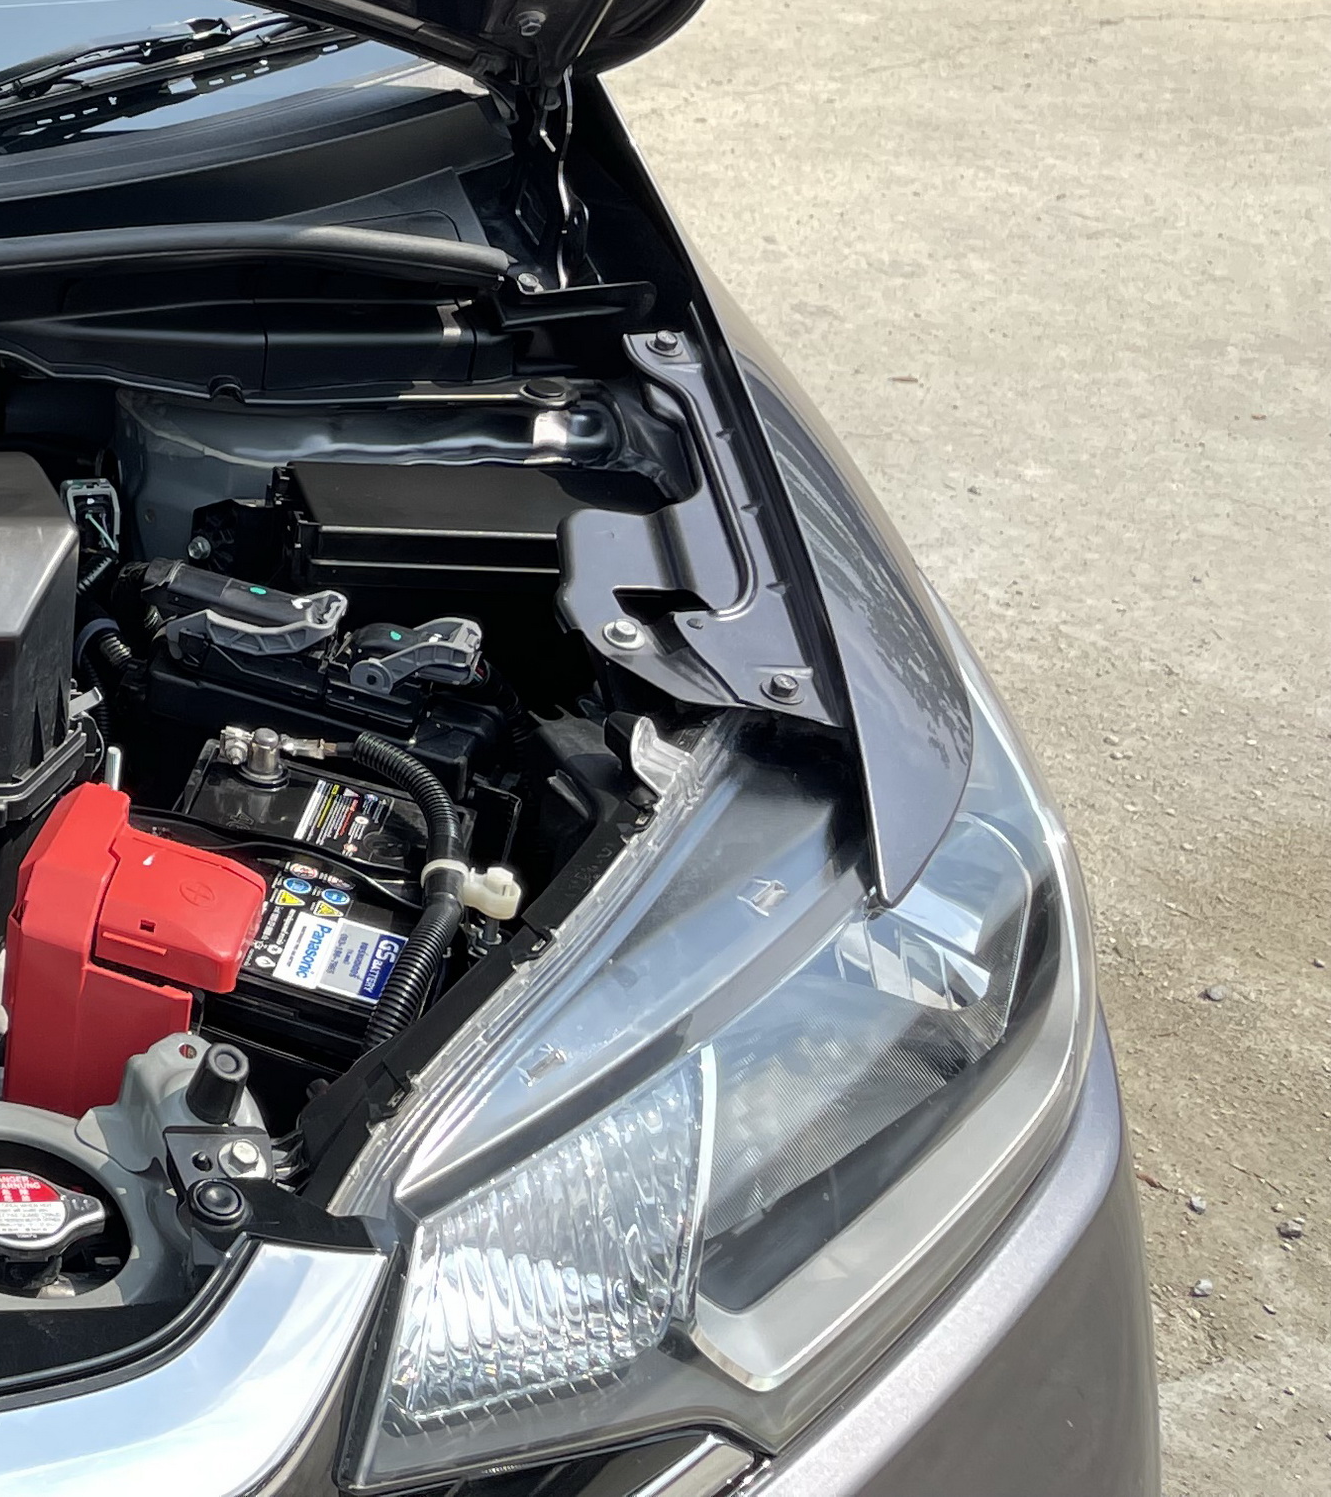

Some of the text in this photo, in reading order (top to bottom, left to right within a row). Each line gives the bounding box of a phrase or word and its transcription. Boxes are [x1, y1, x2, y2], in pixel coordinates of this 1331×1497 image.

[296, 923, 333, 979] Panasonic
[363, 939, 400, 994] GS BATTERY
